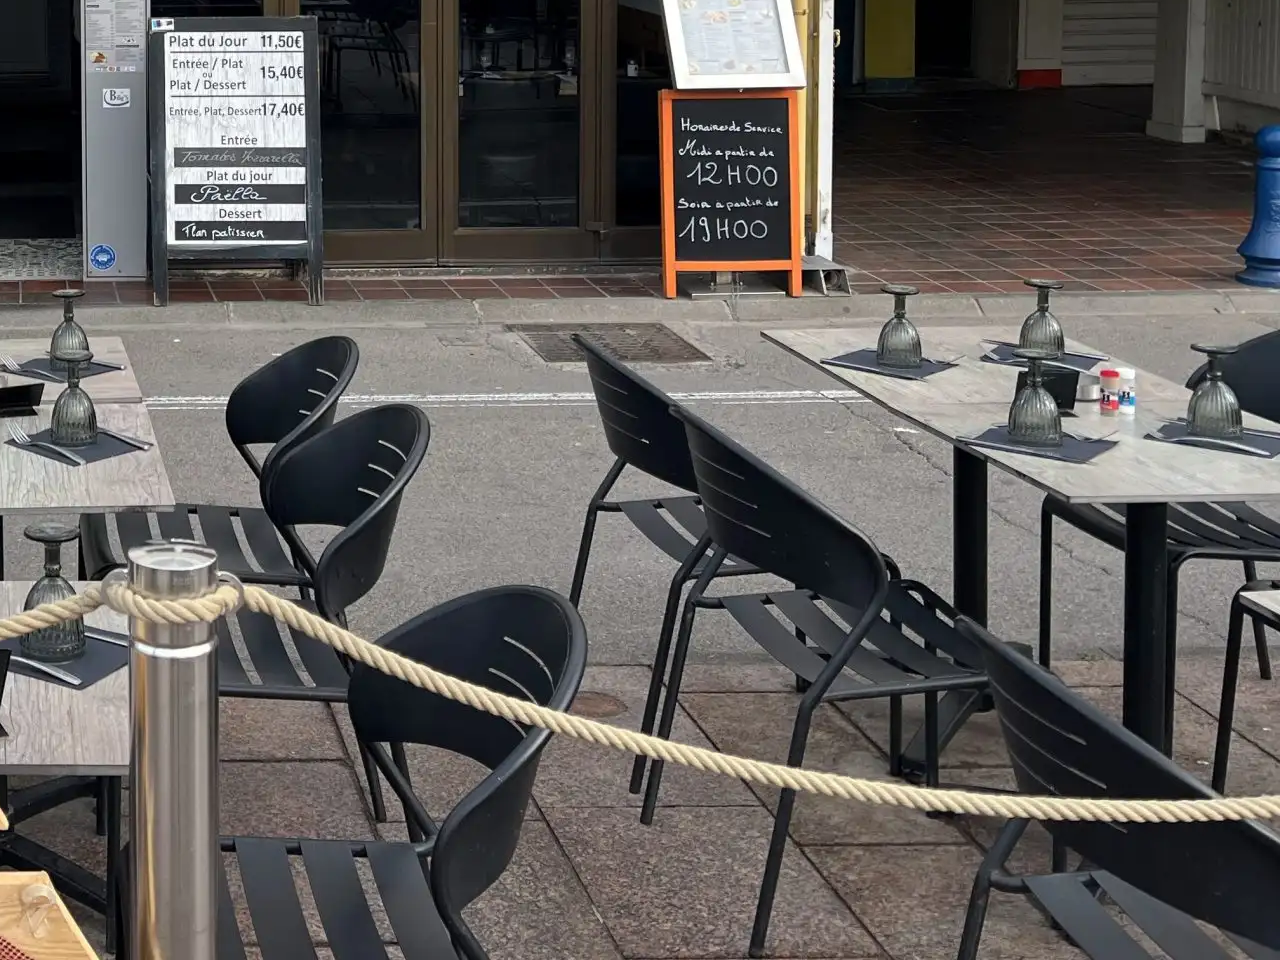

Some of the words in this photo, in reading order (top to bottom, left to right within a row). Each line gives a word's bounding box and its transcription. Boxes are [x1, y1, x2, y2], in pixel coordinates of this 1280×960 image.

[169, 34, 195, 47] Plat
[198, 34, 215, 47] du
[219, 35, 248, 48] Jour
[260, 34, 302, 50] 11,50€
[172, 58, 209, 69] Entrée
[221, 58, 243, 69] Plat
[260, 66, 304, 81] 15,40€
[169, 80, 191, 90] Plat
[203, 80, 247, 90] Dessert
[204, 107, 225, 117] Plat,
[227, 107, 262, 116] Dessert
[261, 103, 305, 118] 17,40€
[744, 122, 783, 134] Service
[220, 135, 258, 145] Entrée
[678, 139, 712, 156] Midi
[759, 146, 775, 157] de
[206, 171, 229, 181] Plat
[231, 171, 247, 181] du
[249, 171, 273, 183] jour
[677, 197, 712, 209] Soir
[219, 208, 262, 219] Dessert
[182, 223, 207, 238] Flan
